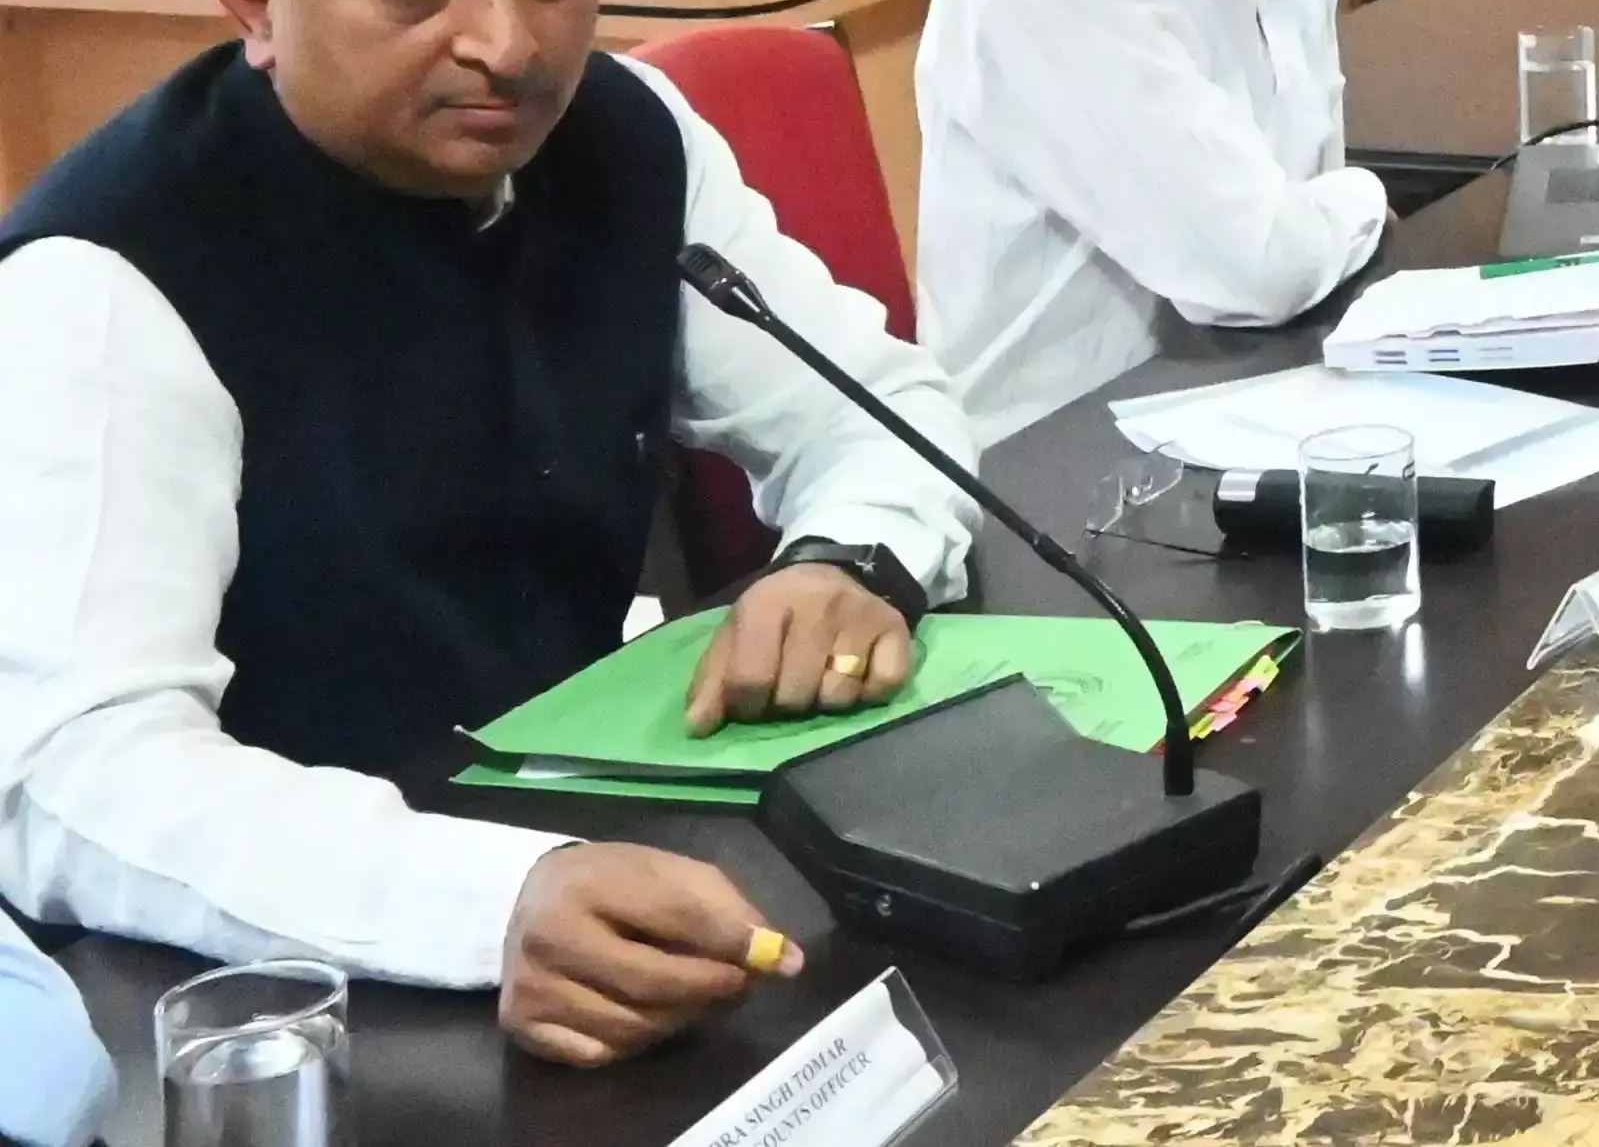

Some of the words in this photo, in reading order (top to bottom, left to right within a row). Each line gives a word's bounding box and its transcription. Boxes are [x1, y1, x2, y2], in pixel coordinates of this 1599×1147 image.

[745, 1083, 794, 1129] SINGH
[793, 1038, 847, 1088] TOMAR
[810, 1052, 871, 1110] OFFICER
